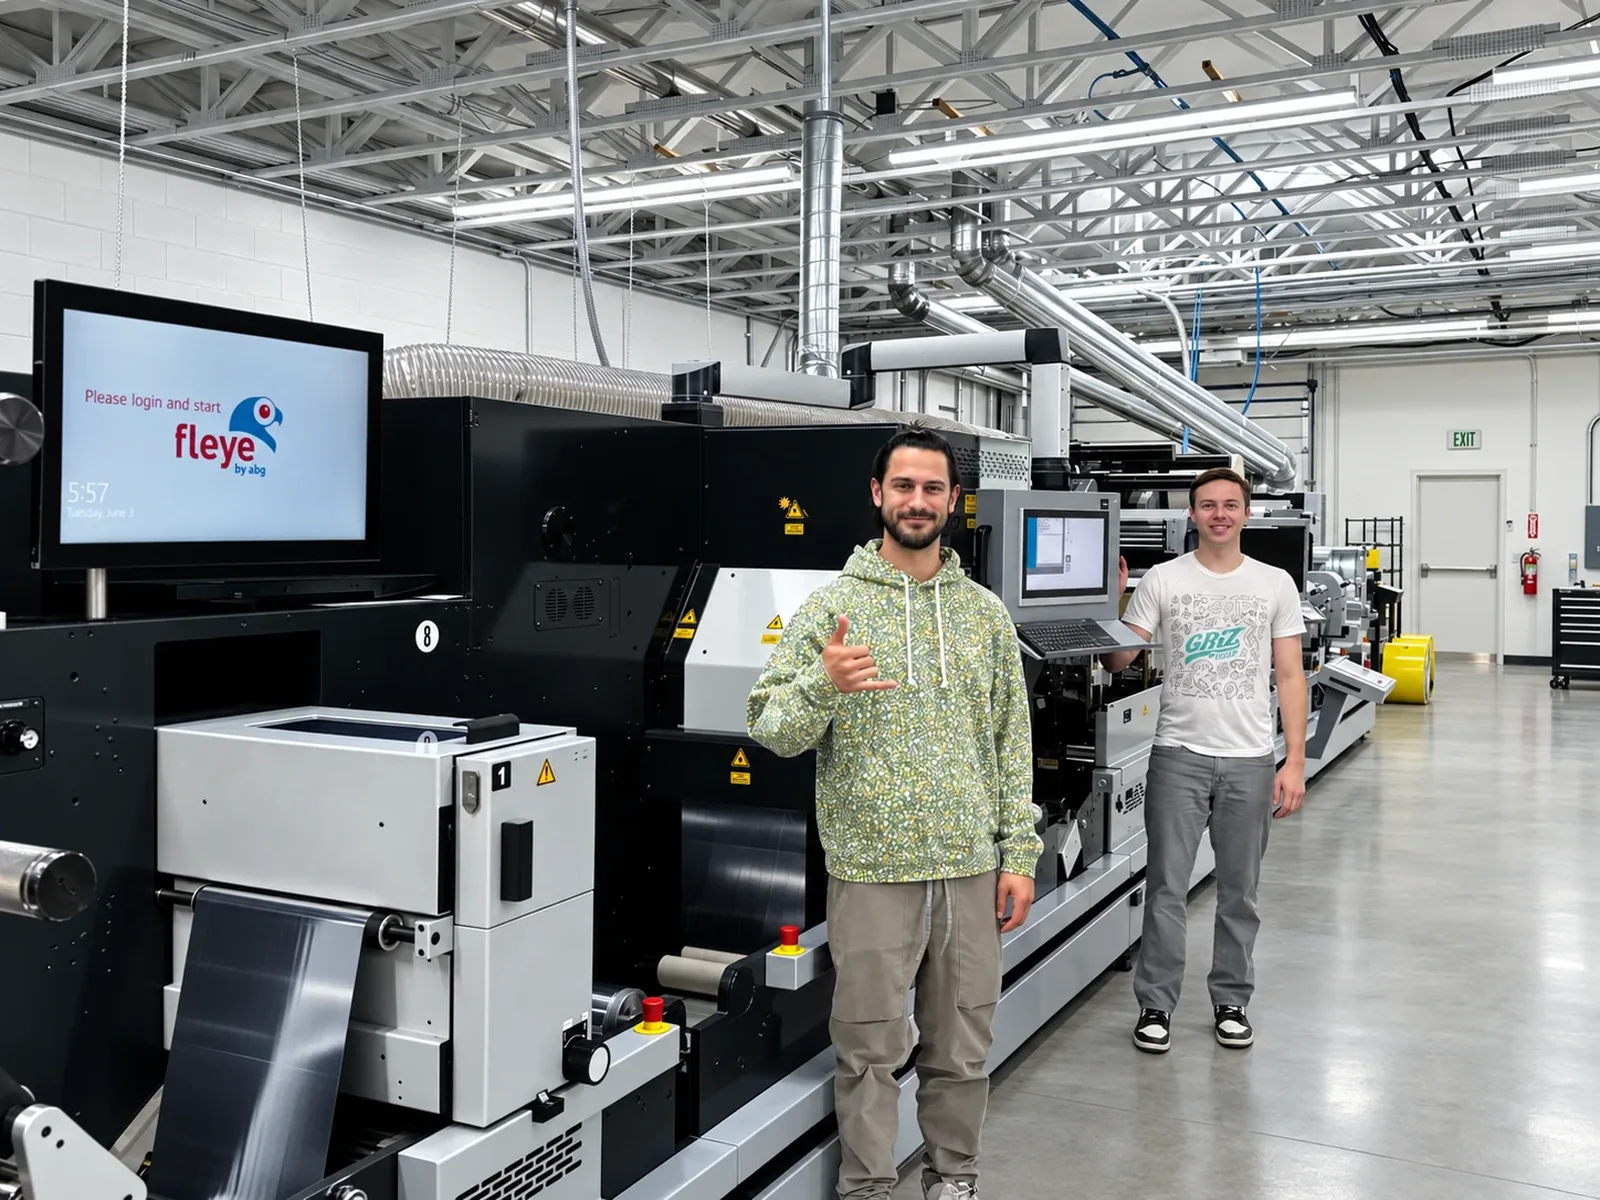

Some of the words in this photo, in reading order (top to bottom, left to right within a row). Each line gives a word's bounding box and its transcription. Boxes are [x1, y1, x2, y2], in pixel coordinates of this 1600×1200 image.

[85, 389, 127, 405] Please
[132, 393, 162, 411] login
[166, 397, 190, 411] and
[194, 401, 221, 413] start
[175, 423, 255, 469] fleye
[1453, 432, 1476, 447] EXIT
[234, 463, 247, 476] by
[248, 464, 266, 477] abg
[68, 482, 109, 503] 5:57
[498, 766, 505, 785] 1
